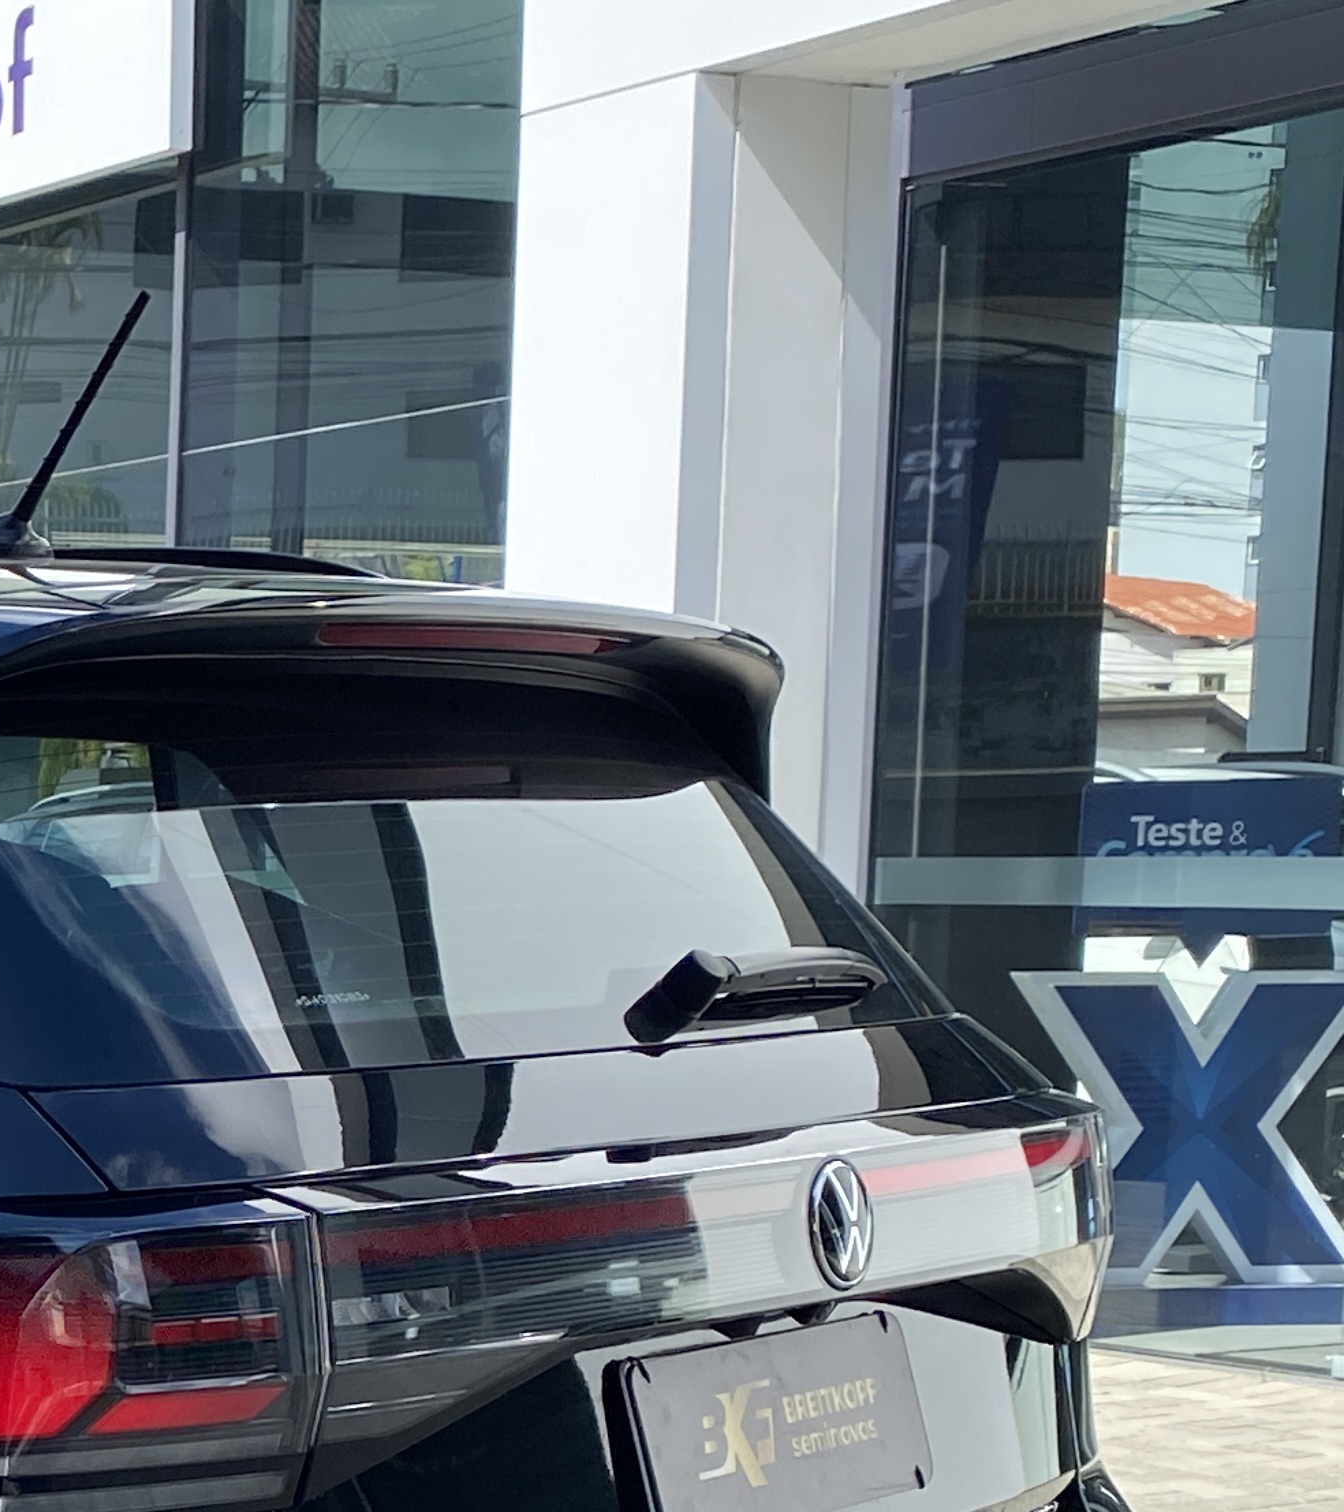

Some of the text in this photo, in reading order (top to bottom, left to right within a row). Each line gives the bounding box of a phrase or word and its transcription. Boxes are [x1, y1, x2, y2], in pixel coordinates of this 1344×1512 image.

[1130, 815, 1248, 847] Teste &
[781, 1377, 877, 1424] BREITKOPF
[792, 1419, 878, 1457] seminovos
